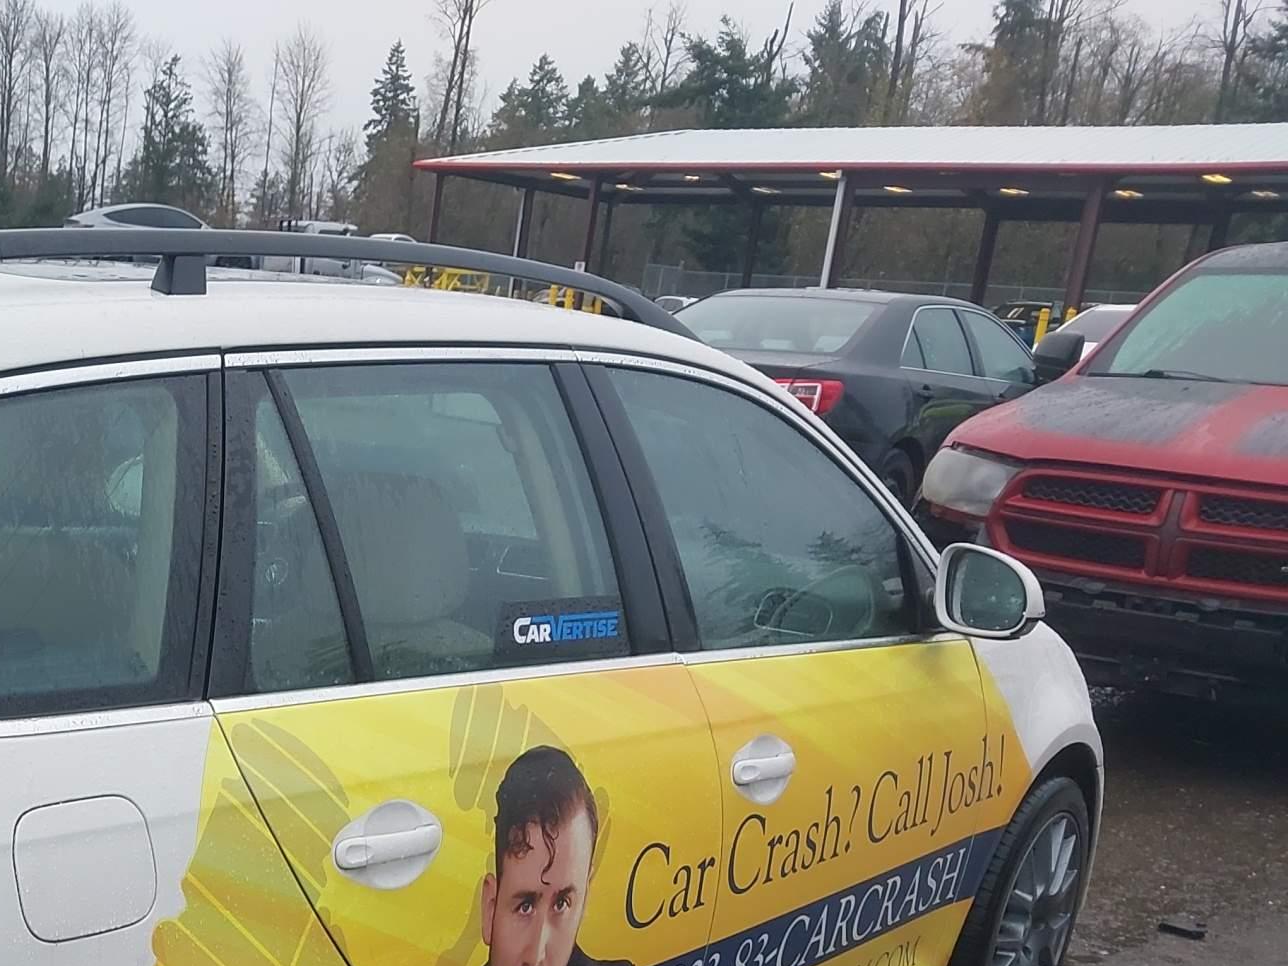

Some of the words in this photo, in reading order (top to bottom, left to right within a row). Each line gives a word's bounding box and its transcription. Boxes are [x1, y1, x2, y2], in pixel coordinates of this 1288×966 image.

[625, 842, 716, 929] Car
[727, 784, 861, 895] Crash?
[867, 752, 934, 843] Call
[931, 734, 1005, 837] Josh!
